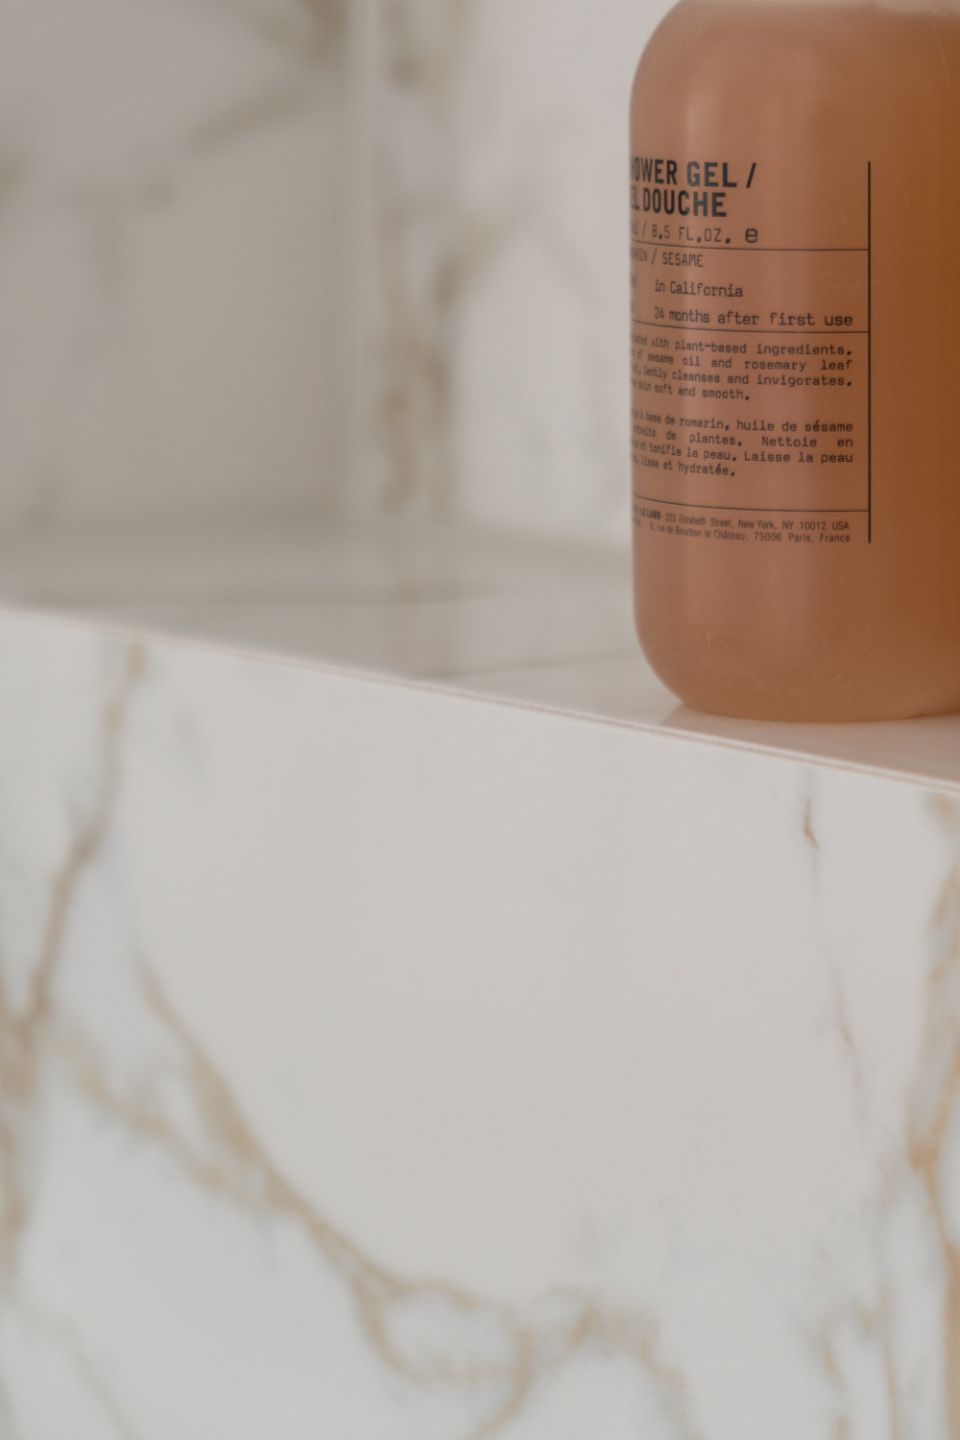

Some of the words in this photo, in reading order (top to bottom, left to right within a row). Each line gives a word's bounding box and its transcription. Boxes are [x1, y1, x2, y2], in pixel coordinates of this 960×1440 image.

[631, 156, 678, 185] OWER
[687, 161, 737, 189] GEL
[643, 188, 727, 217] DOUCHE
[651, 224, 671, 240] 8.5
[662, 252, 704, 268] SESAME
[655, 280, 666, 293] in
[670, 281, 743, 298] California
[653, 307, 665, 320] 24
[669, 310, 710, 324] months
[717, 312, 759, 326] after
[770, 312, 815, 326] first
[824, 315, 853, 327] use
[675, 340, 747, 354] plant-based
[757, 344, 852, 356] ingredients.
[682, 356, 700, 366] oil
[711, 358, 732, 369] and
[744, 361, 806, 372] rosemary
[821, 360, 852, 371] leaf
[672, 371, 720, 384] cleanses
[728, 374, 749, 385] and
[756, 374, 852, 387] invigorates.
[678, 386, 696, 397] and
[702, 389, 750, 401] smooth.
[665, 414, 675, 425] de
[680, 417, 729, 431] romarin,
[736, 419, 775, 431] huile
[781, 421, 797, 432] de
[804, 420, 853, 432] sésame
[666, 430, 676, 440] de
[689, 432, 742, 447] plantes.
[761, 436, 817, 448] Nettoie
[837, 438, 853, 448] en
[687, 447, 698, 458] la
[703, 450, 737, 462] peau.
[744, 451, 791, 462] Laisse
[798, 452, 813, 463] la
[820, 454, 853, 465] peau
[678, 461, 735, 477] hydratée.
[738, 520, 754, 529] New
[782, 521, 794, 530] NY
[801, 521, 826, 531] 10012
[832, 521, 850, 531] USA
[820, 533, 850, 543] France
